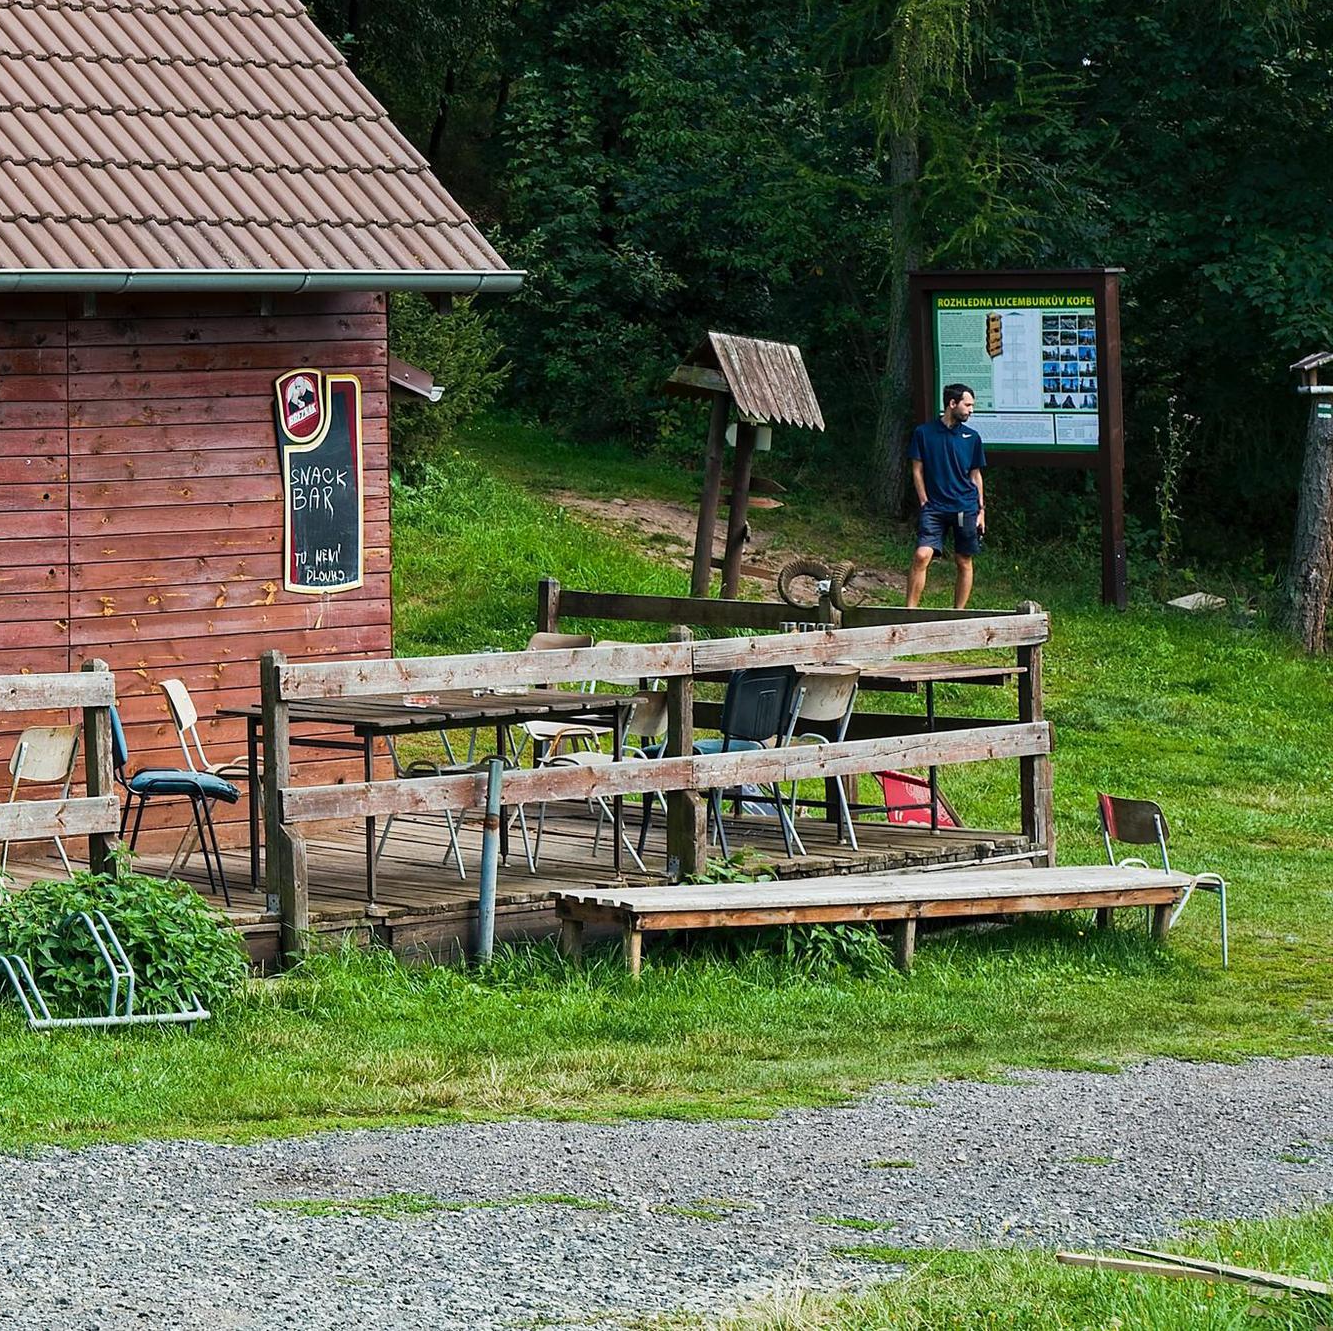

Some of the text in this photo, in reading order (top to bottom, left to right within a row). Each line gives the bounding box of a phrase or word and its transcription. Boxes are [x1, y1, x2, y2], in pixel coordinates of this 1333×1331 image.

[937, 297, 993, 308] ROZHLEDNA
[994, 294, 1065, 307] LUCEMBURKŮV
[290, 466, 348, 488] SNACK
[293, 486, 334, 516] BAR
